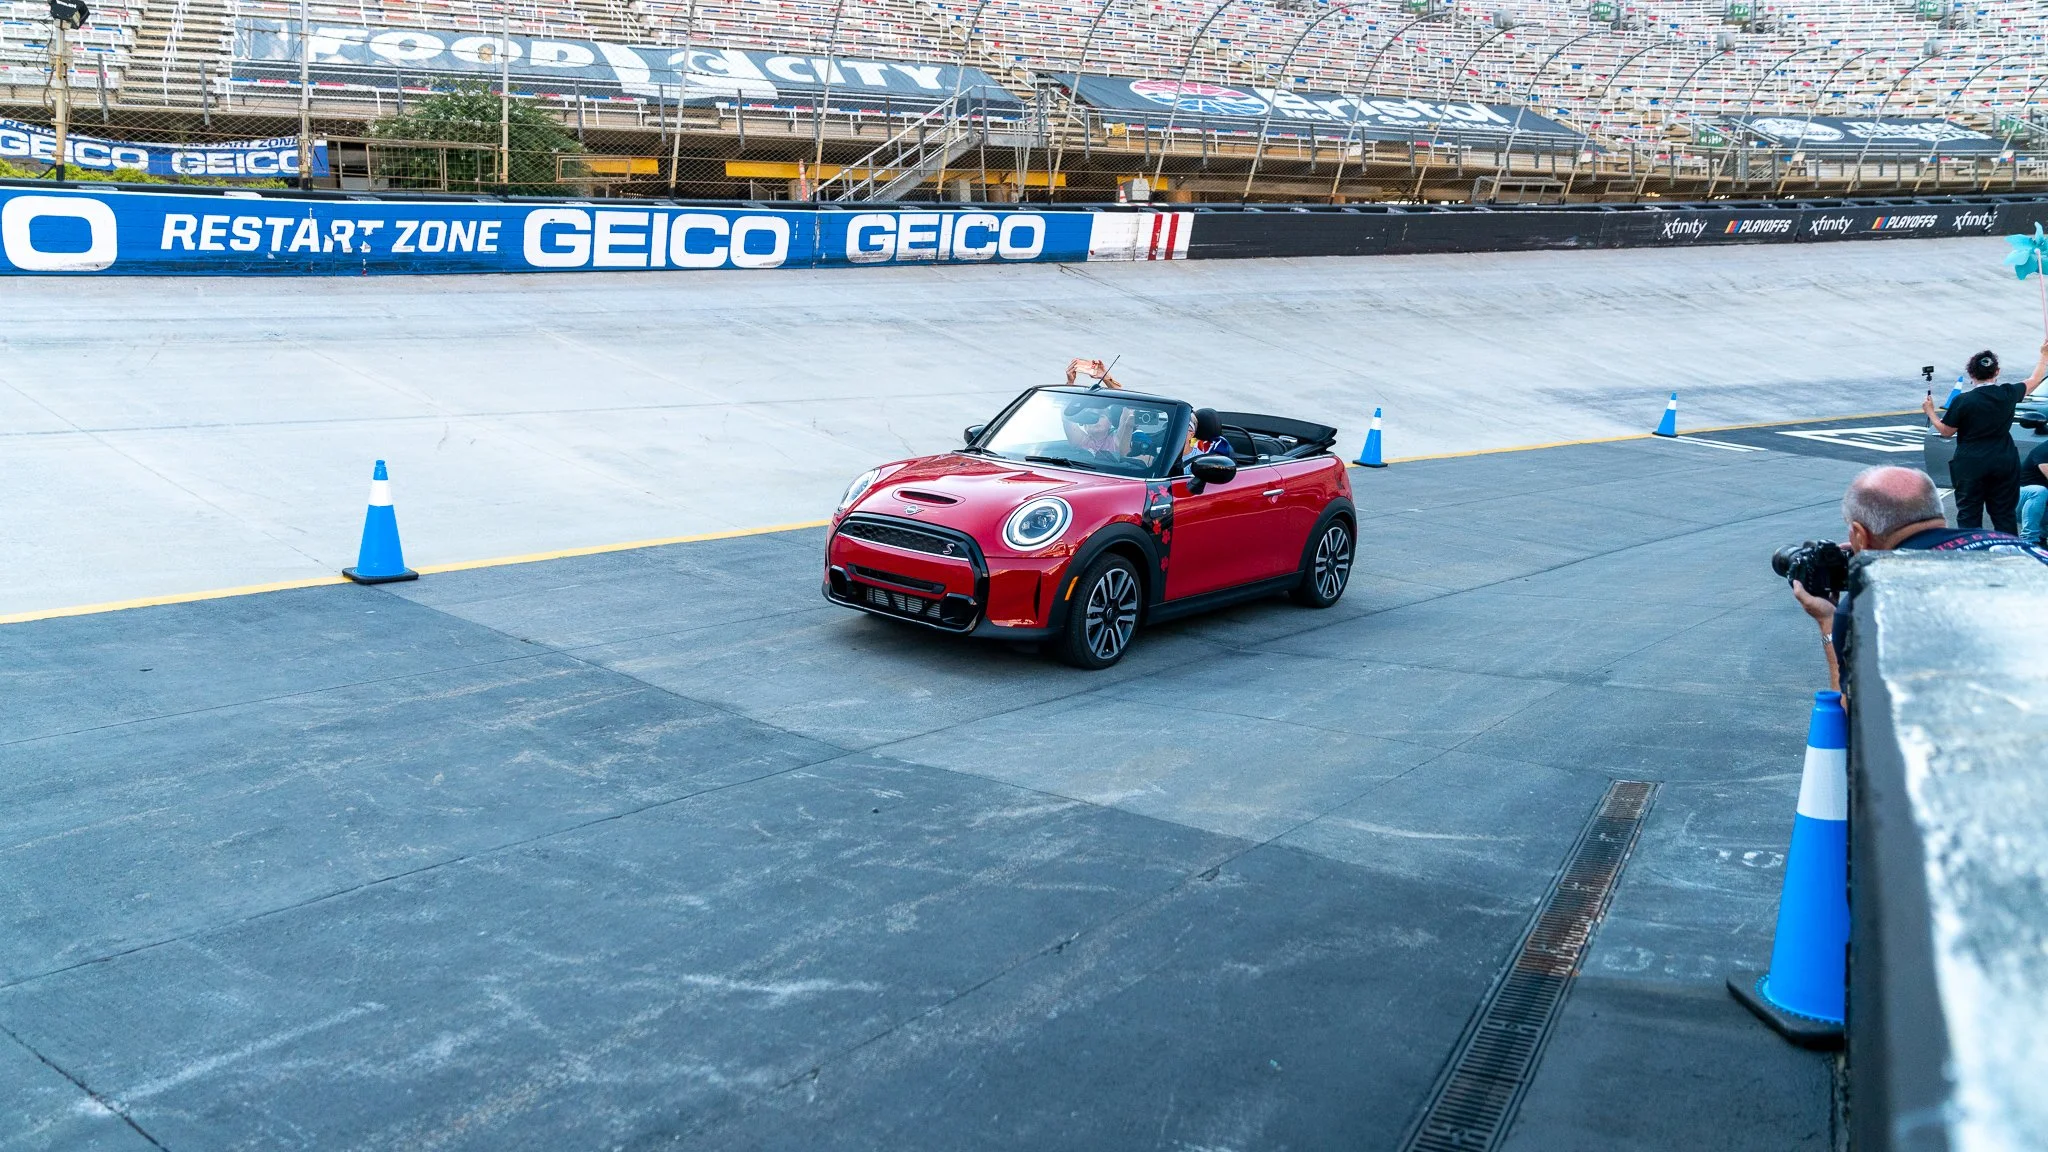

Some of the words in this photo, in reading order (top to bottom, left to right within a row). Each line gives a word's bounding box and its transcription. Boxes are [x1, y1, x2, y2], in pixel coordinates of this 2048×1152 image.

[306, 26, 595, 69] FOOD
[765, 56, 943, 90] CITY
[1253, 87, 1511, 124] Bristol
[0, 129, 149, 169] GEICO
[172, 150, 311, 175] GEICO
[160, 214, 384, 253] RESTART
[392, 220, 502, 253] ZONE
[523, 208, 790, 269] GEICO
[846, 213, 1046, 264] GEICO
[1661, 217, 1708, 239] xfinity
[1738, 219, 1792, 234] PLAYOFFS
[1808, 215, 1854, 236] xfinity
[1885, 214, 1939, 229] PLAYOFFS
[1952, 210, 1998, 233] xfinity
